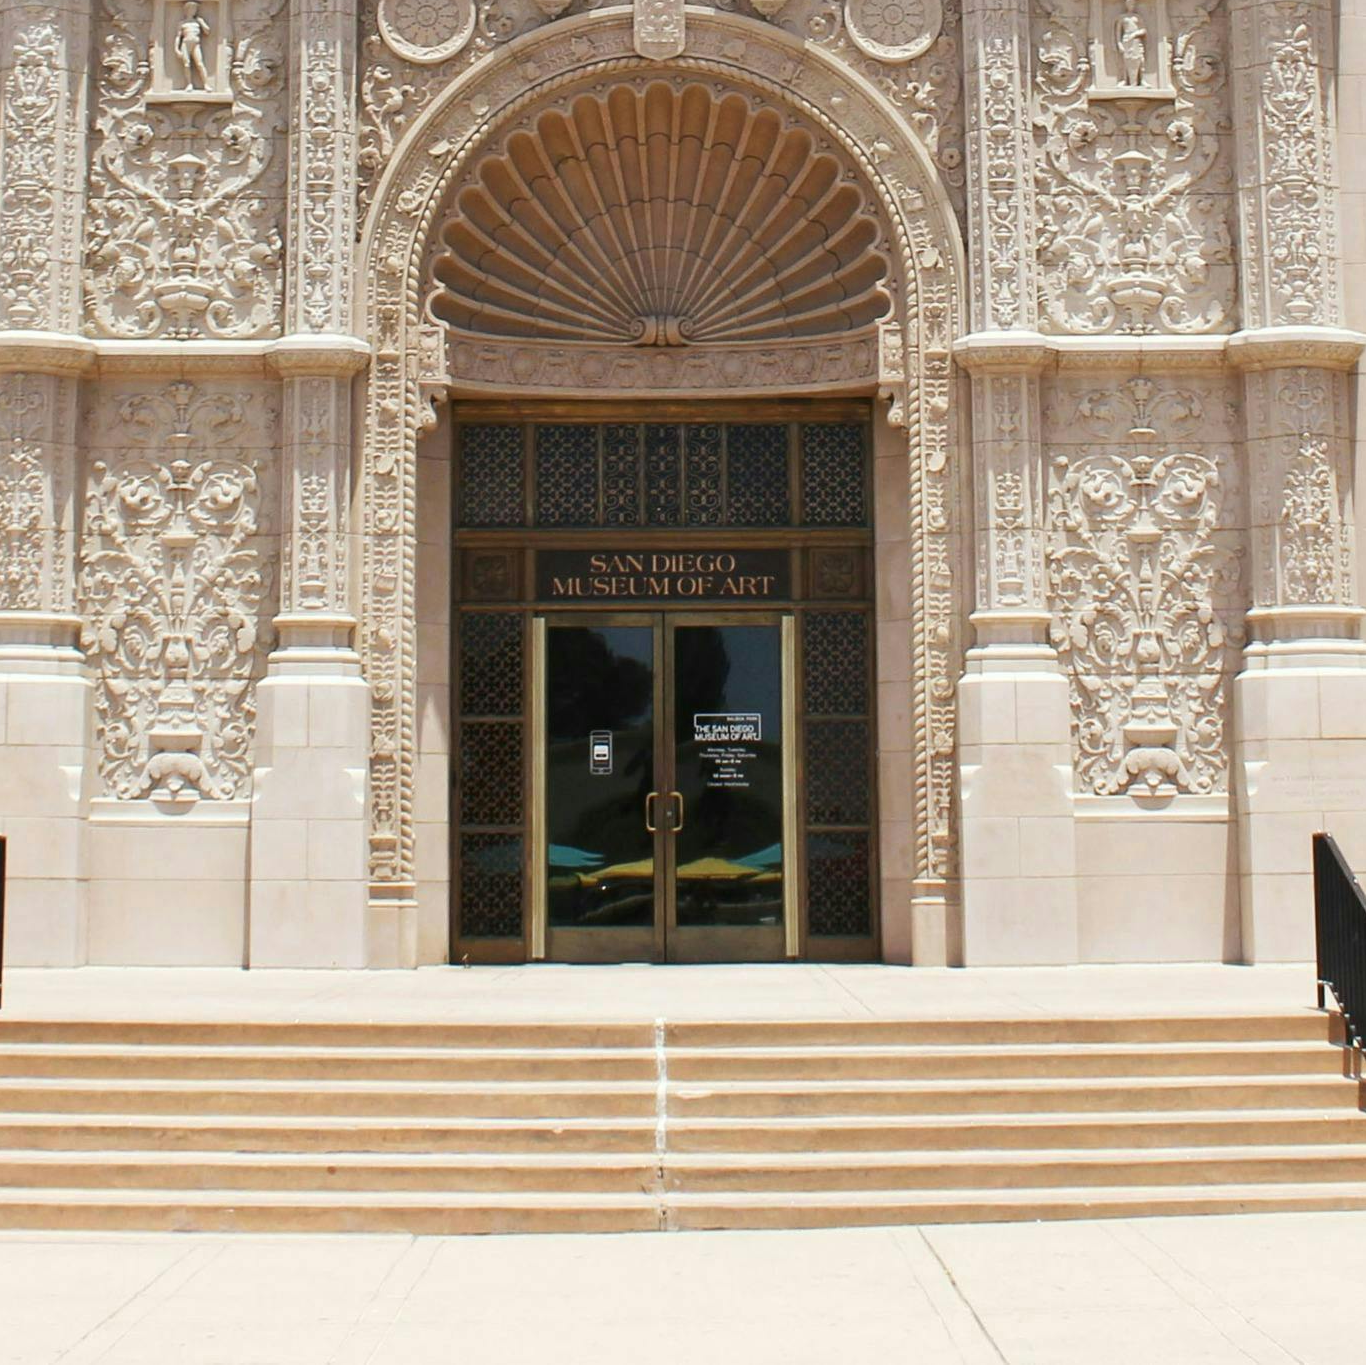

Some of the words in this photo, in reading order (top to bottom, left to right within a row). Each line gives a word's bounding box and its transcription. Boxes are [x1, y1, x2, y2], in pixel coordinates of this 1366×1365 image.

[590, 554, 643, 573] SAN
[651, 554, 736, 573] DIEGO
[552, 577, 670, 596] MUSEUM
[677, 576, 714, 595] OF
[719, 575, 775, 595] ART
[696, 725, 710, 733] THE
[711, 725, 728, 733] SAN
[730, 725, 754, 733] DIEGO
